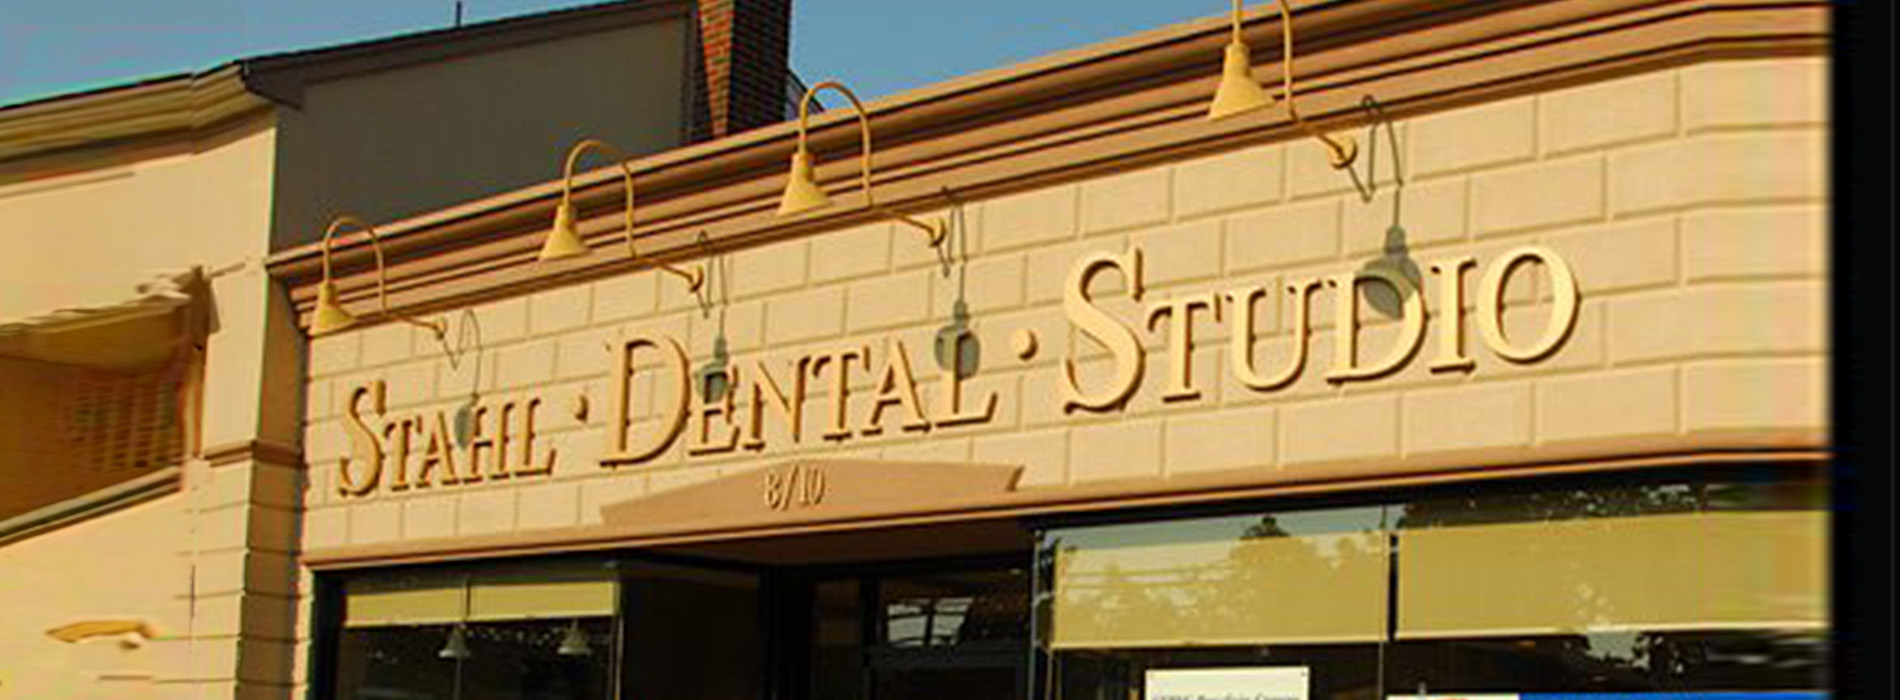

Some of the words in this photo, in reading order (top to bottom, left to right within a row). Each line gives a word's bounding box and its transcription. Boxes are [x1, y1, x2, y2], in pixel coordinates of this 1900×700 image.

[338, 379, 558, 498] STAHL
[599, 333, 1000, 468] DENTAL
[1062, 246, 1582, 414] STUDIO
